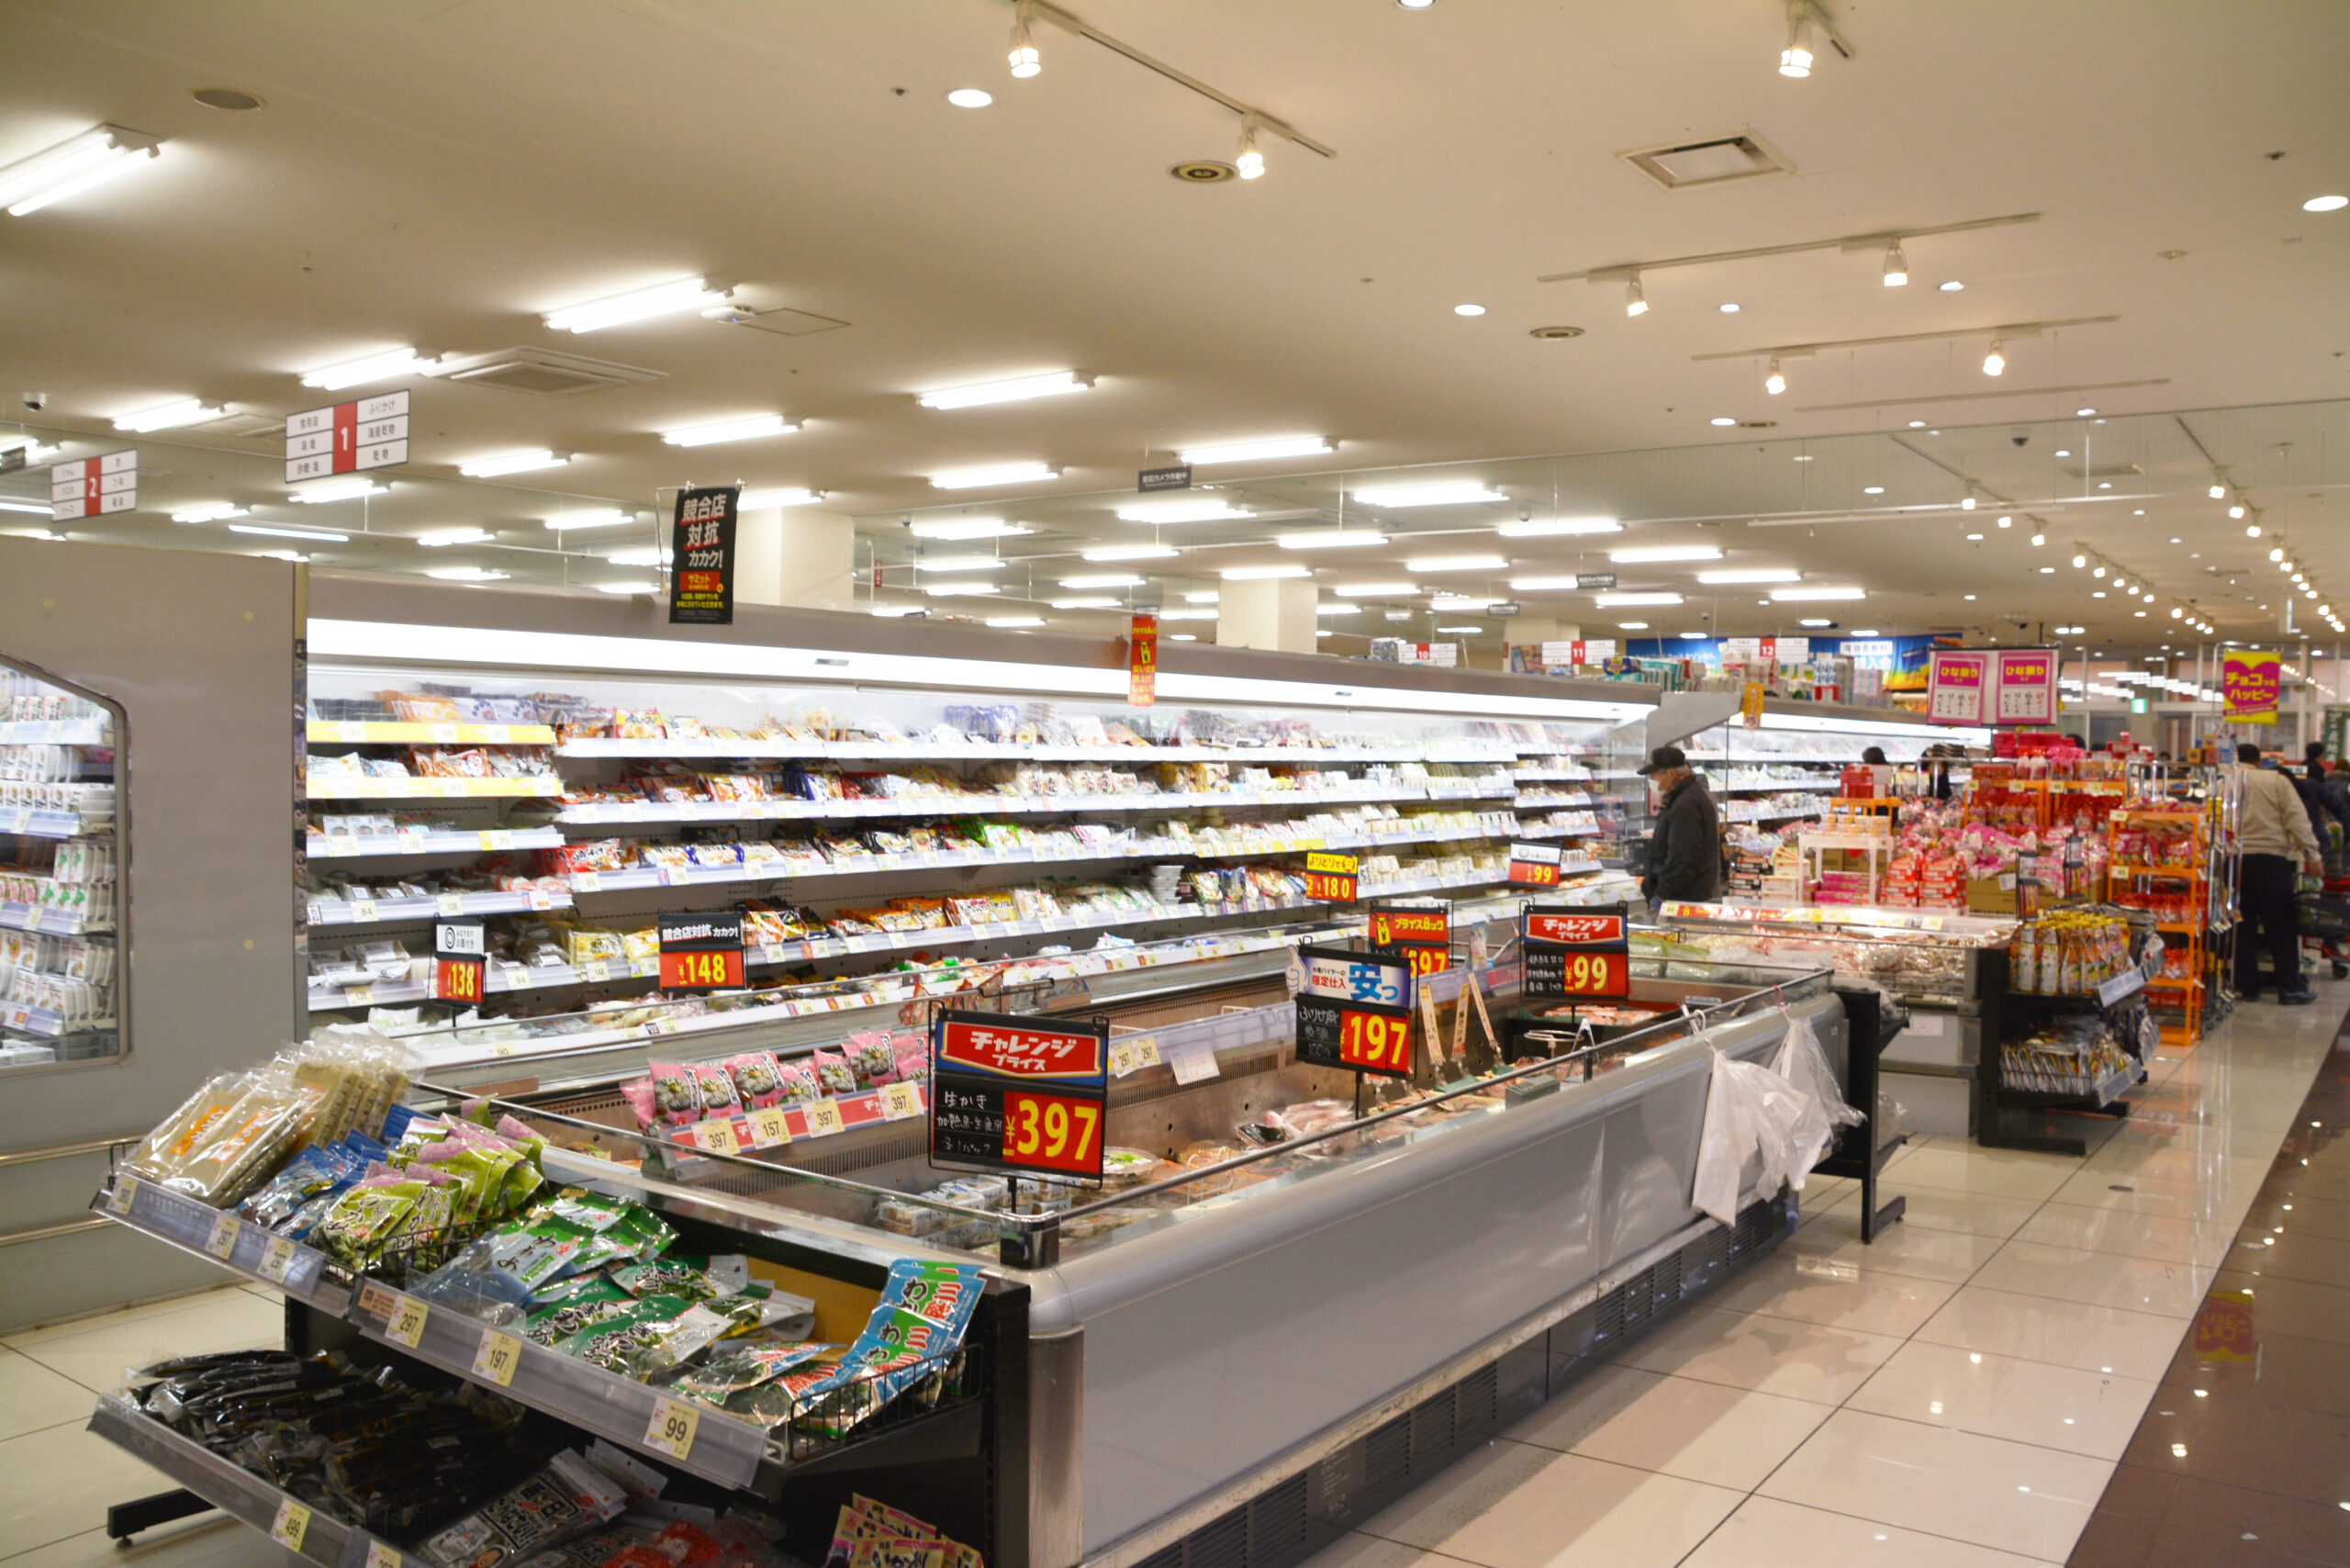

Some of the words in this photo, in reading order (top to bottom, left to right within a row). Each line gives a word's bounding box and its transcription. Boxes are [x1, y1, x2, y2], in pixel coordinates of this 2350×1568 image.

[341, 426, 348, 451] 1
[89, 477, 97, 498] 2
[682, 494, 727, 522] 競合店
[688, 521, 720, 548] 対抗
[1416, 650, 1428, 660] 10
[1572, 647, 1583, 657] 11
[1761, 645, 1774, 655] 12
[1941, 666, 1978, 678] ひな祭り
[2006, 666, 2044, 677] ひな祭り
[2231, 689, 2274, 701] ハッピー
[1534, 865, 1552, 883] 99
[1543, 919, 1608, 933] チャレンジ
[1557, 931, 1591, 941] プライス
[451, 963, 475, 997] 138
[970, 1031, 1077, 1058] チャレンジ
[991, 1054, 1046, 1071] プライス
[891, 1094, 907, 1111] 397
[945, 1091, 988, 1110] 生かき
[816, 1110, 834, 1126] 397
[762, 1121, 780, 1137] 157
[708, 1132, 728, 1148] 397
[399, 1312, 420, 1333] 297
[488, 1348, 509, 1372] 197
[665, 1417, 688, 1442] 99
